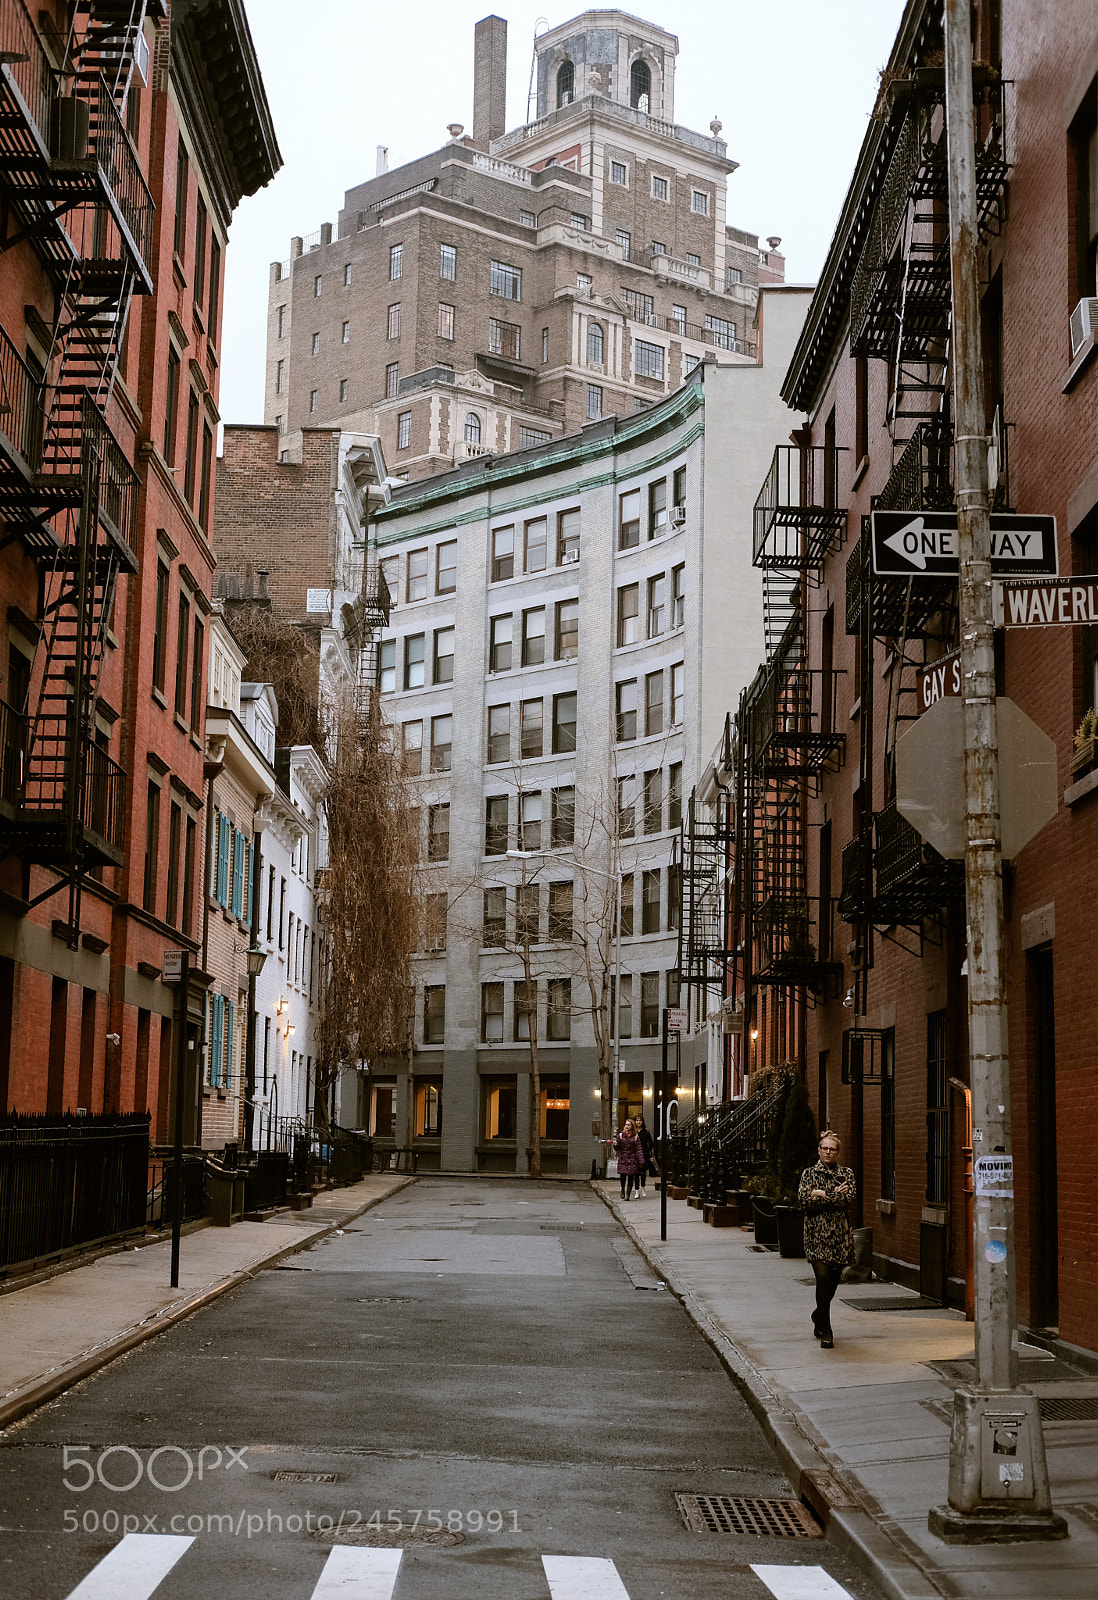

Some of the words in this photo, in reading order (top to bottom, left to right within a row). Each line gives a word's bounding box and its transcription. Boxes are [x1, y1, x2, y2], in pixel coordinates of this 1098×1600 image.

[903, 532, 953, 555] ONE
[1008, 586, 1098, 624] WAVERL
[923, 666, 946, 707] GAY
[952, 657, 962, 693] S
[979, 1162, 1012, 1171] MOVING
